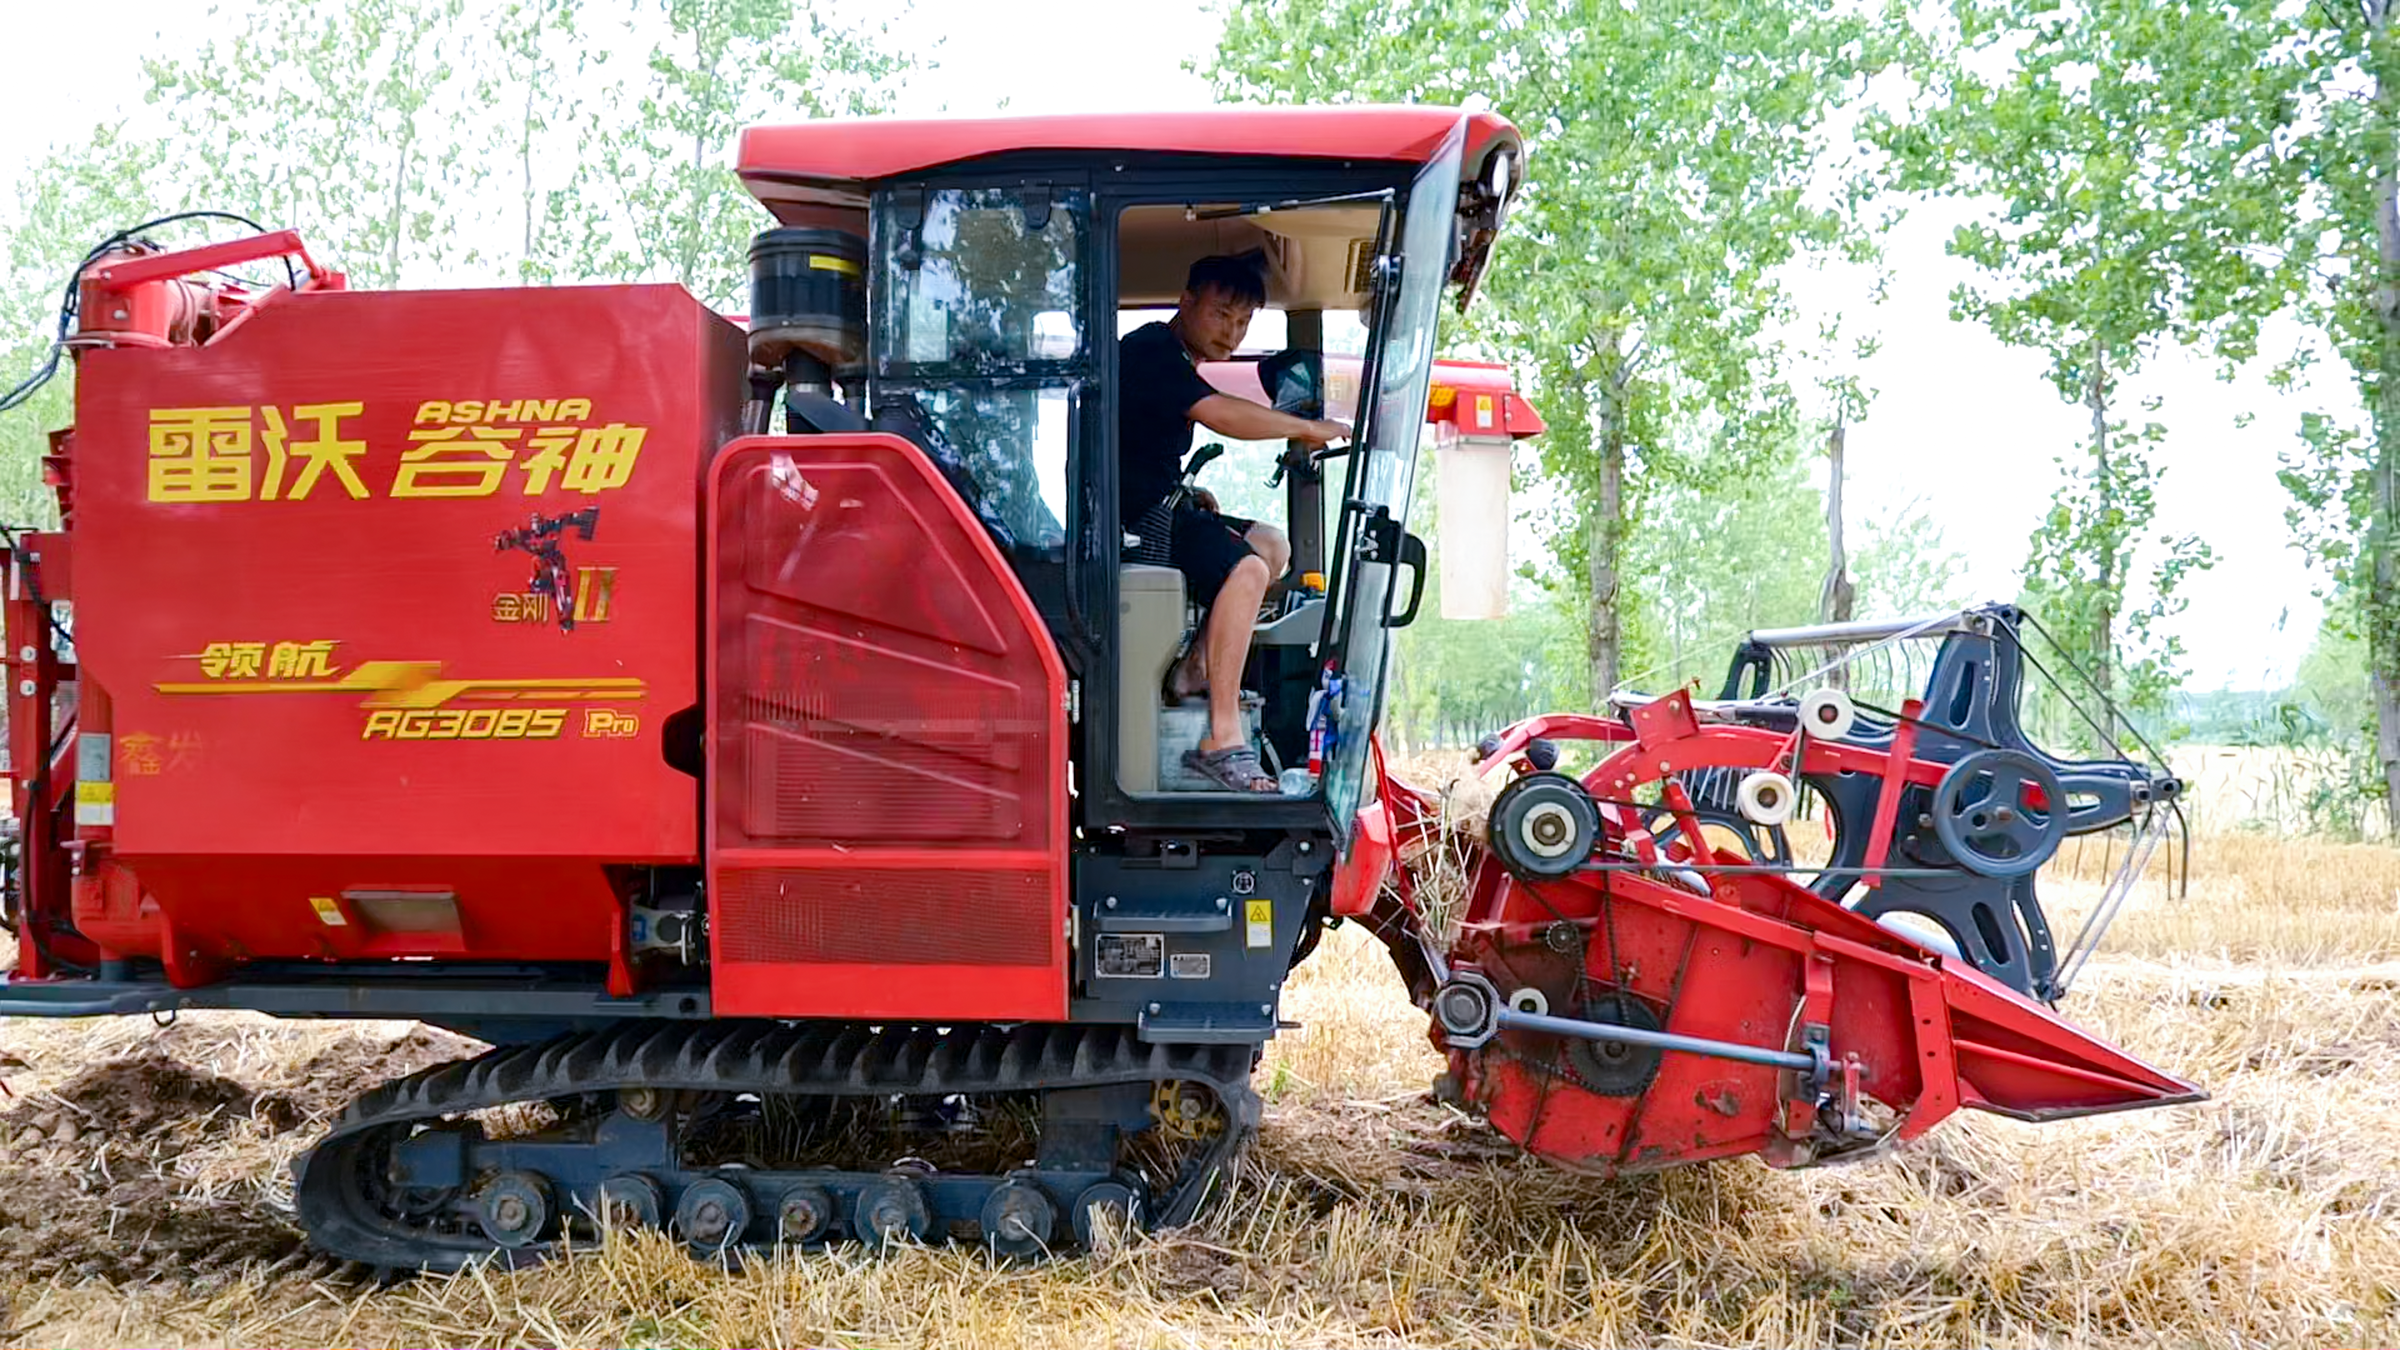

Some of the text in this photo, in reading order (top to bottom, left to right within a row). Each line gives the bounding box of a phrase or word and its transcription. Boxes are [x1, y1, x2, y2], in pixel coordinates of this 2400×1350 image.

[414, 398, 591, 423] ASHNA
[149, 402, 647, 502] 雷沃 谷神
[201, 640, 341, 678] 领航
[362, 709, 639, 739] AG3085 Pro
